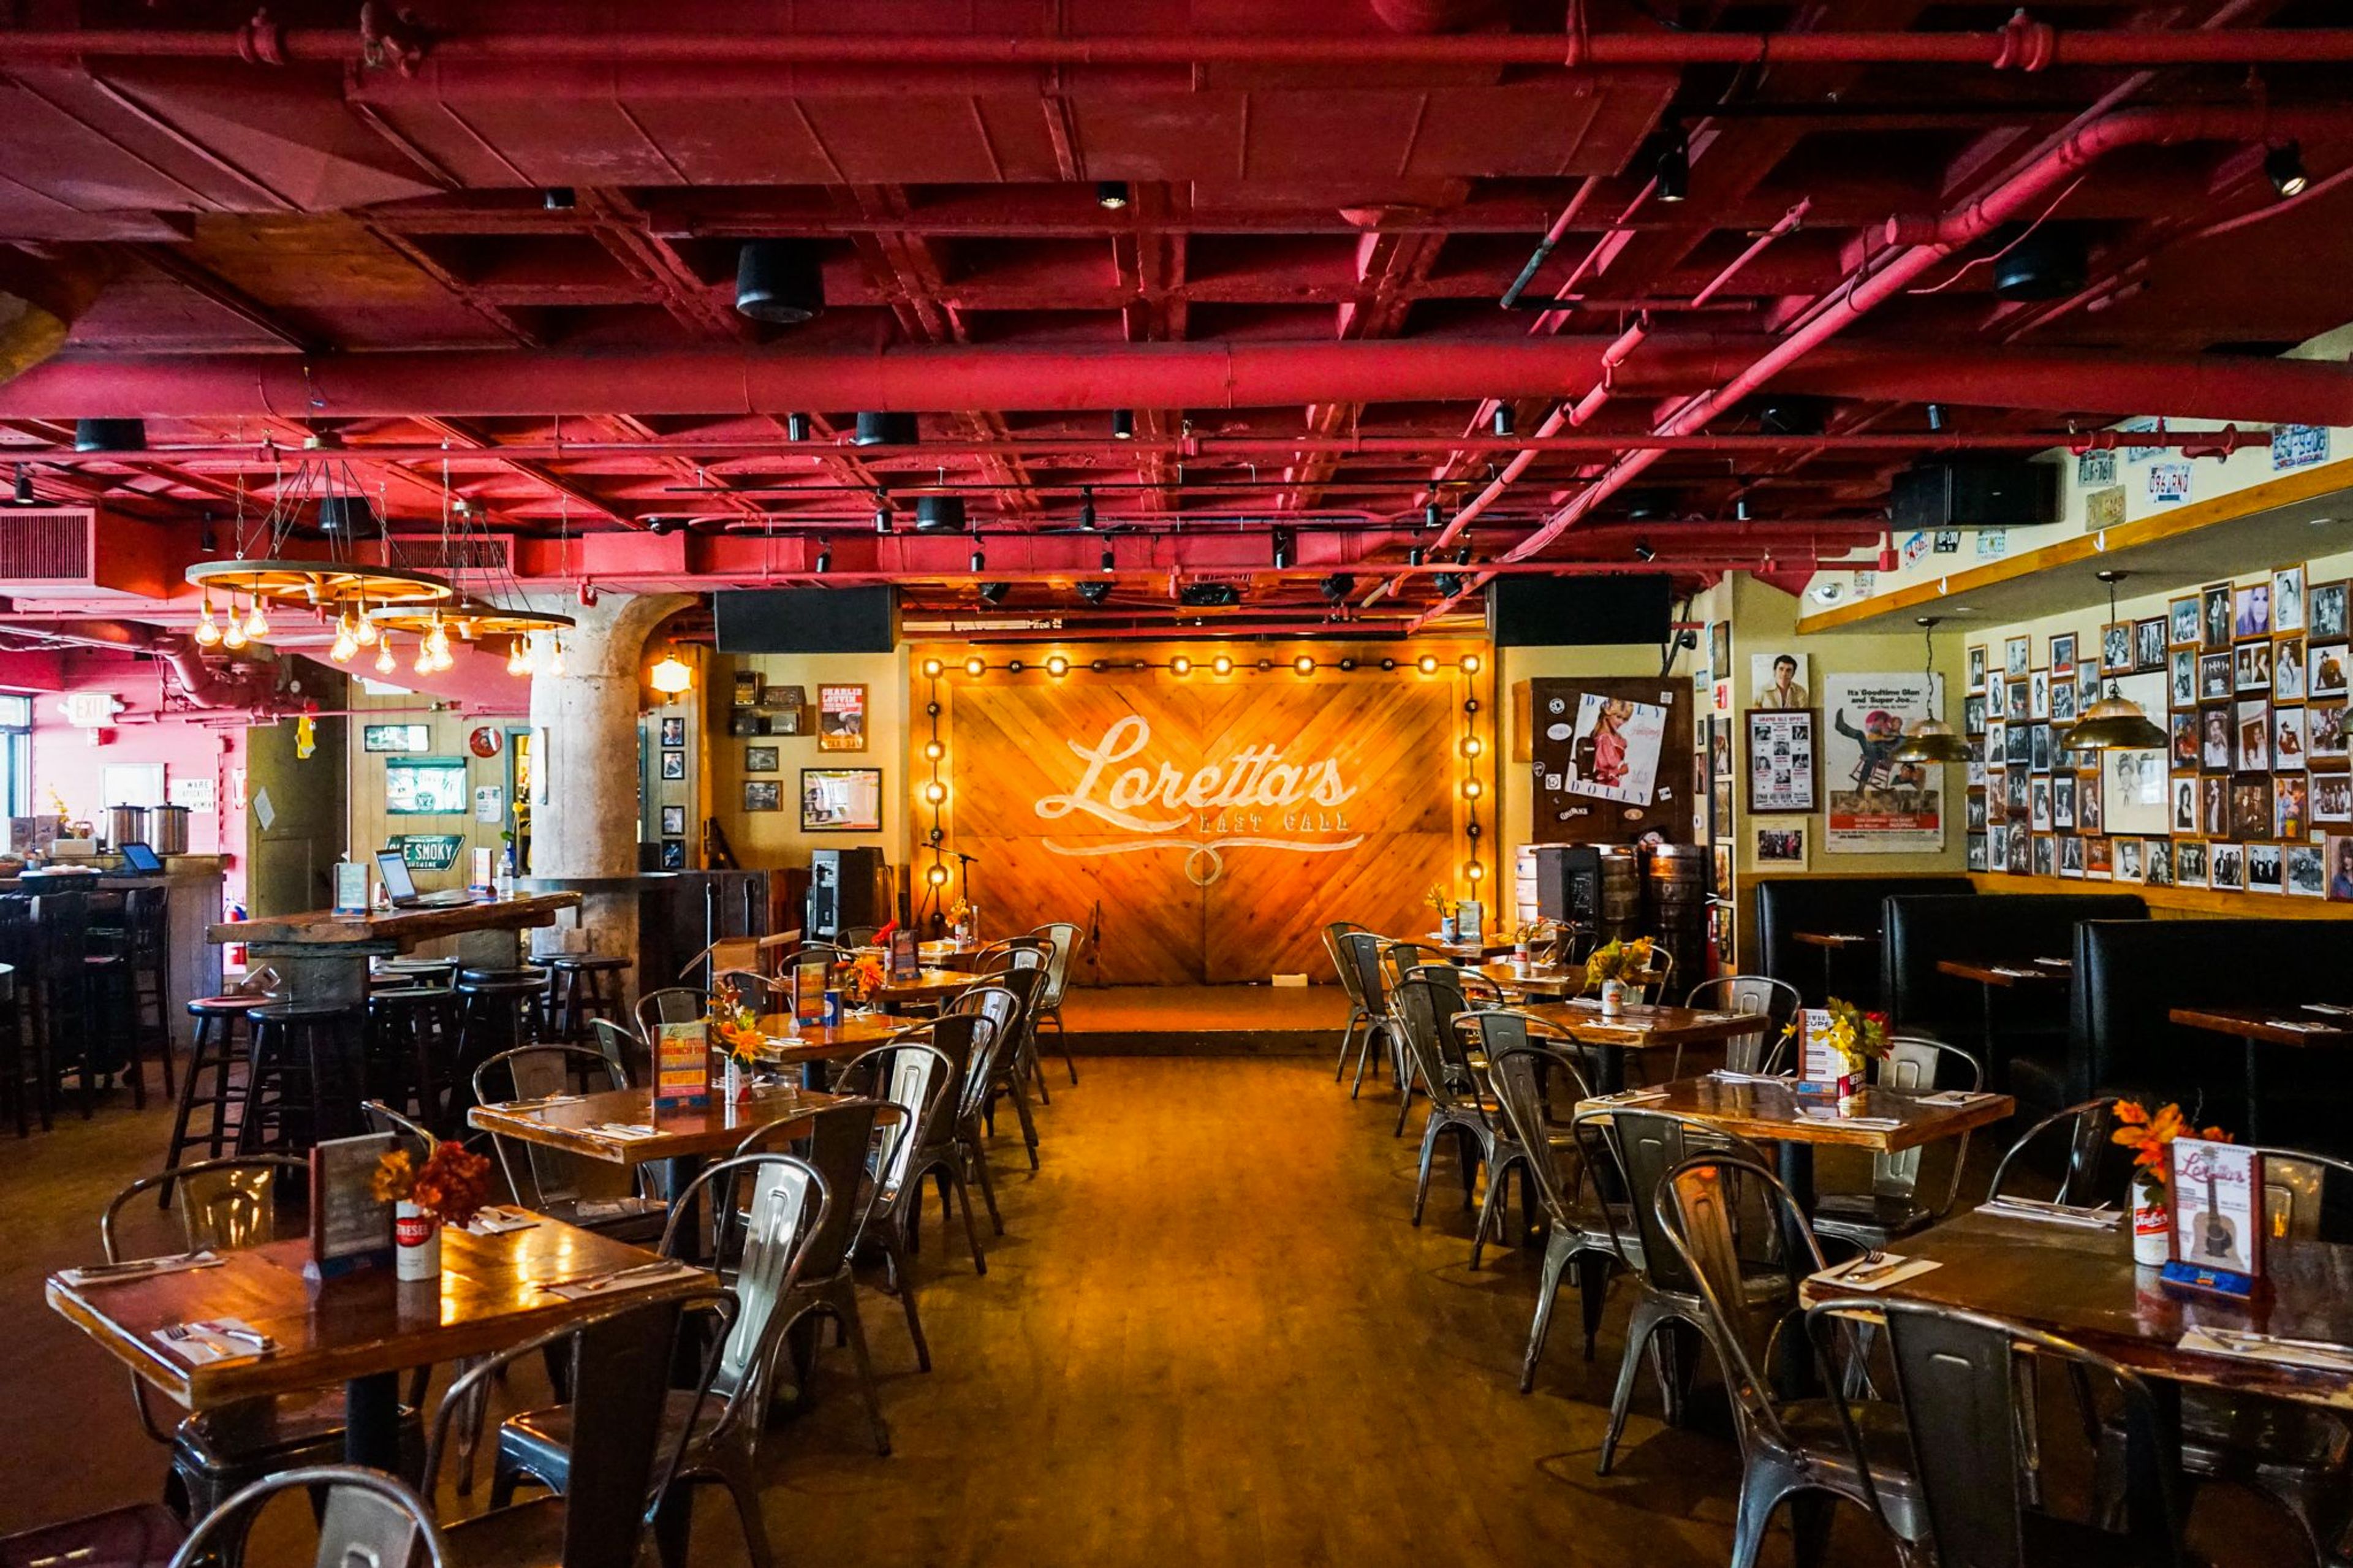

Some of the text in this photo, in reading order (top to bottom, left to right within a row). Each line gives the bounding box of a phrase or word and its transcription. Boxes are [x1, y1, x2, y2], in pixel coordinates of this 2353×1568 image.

[76, 697, 107, 718] EXIT
[1035, 715, 1357, 832] Loretta's
[1569, 780, 1648, 804] DOLLY
[1199, 812, 1349, 833] LAST CALL
[415, 844, 452, 860] SMOKY
